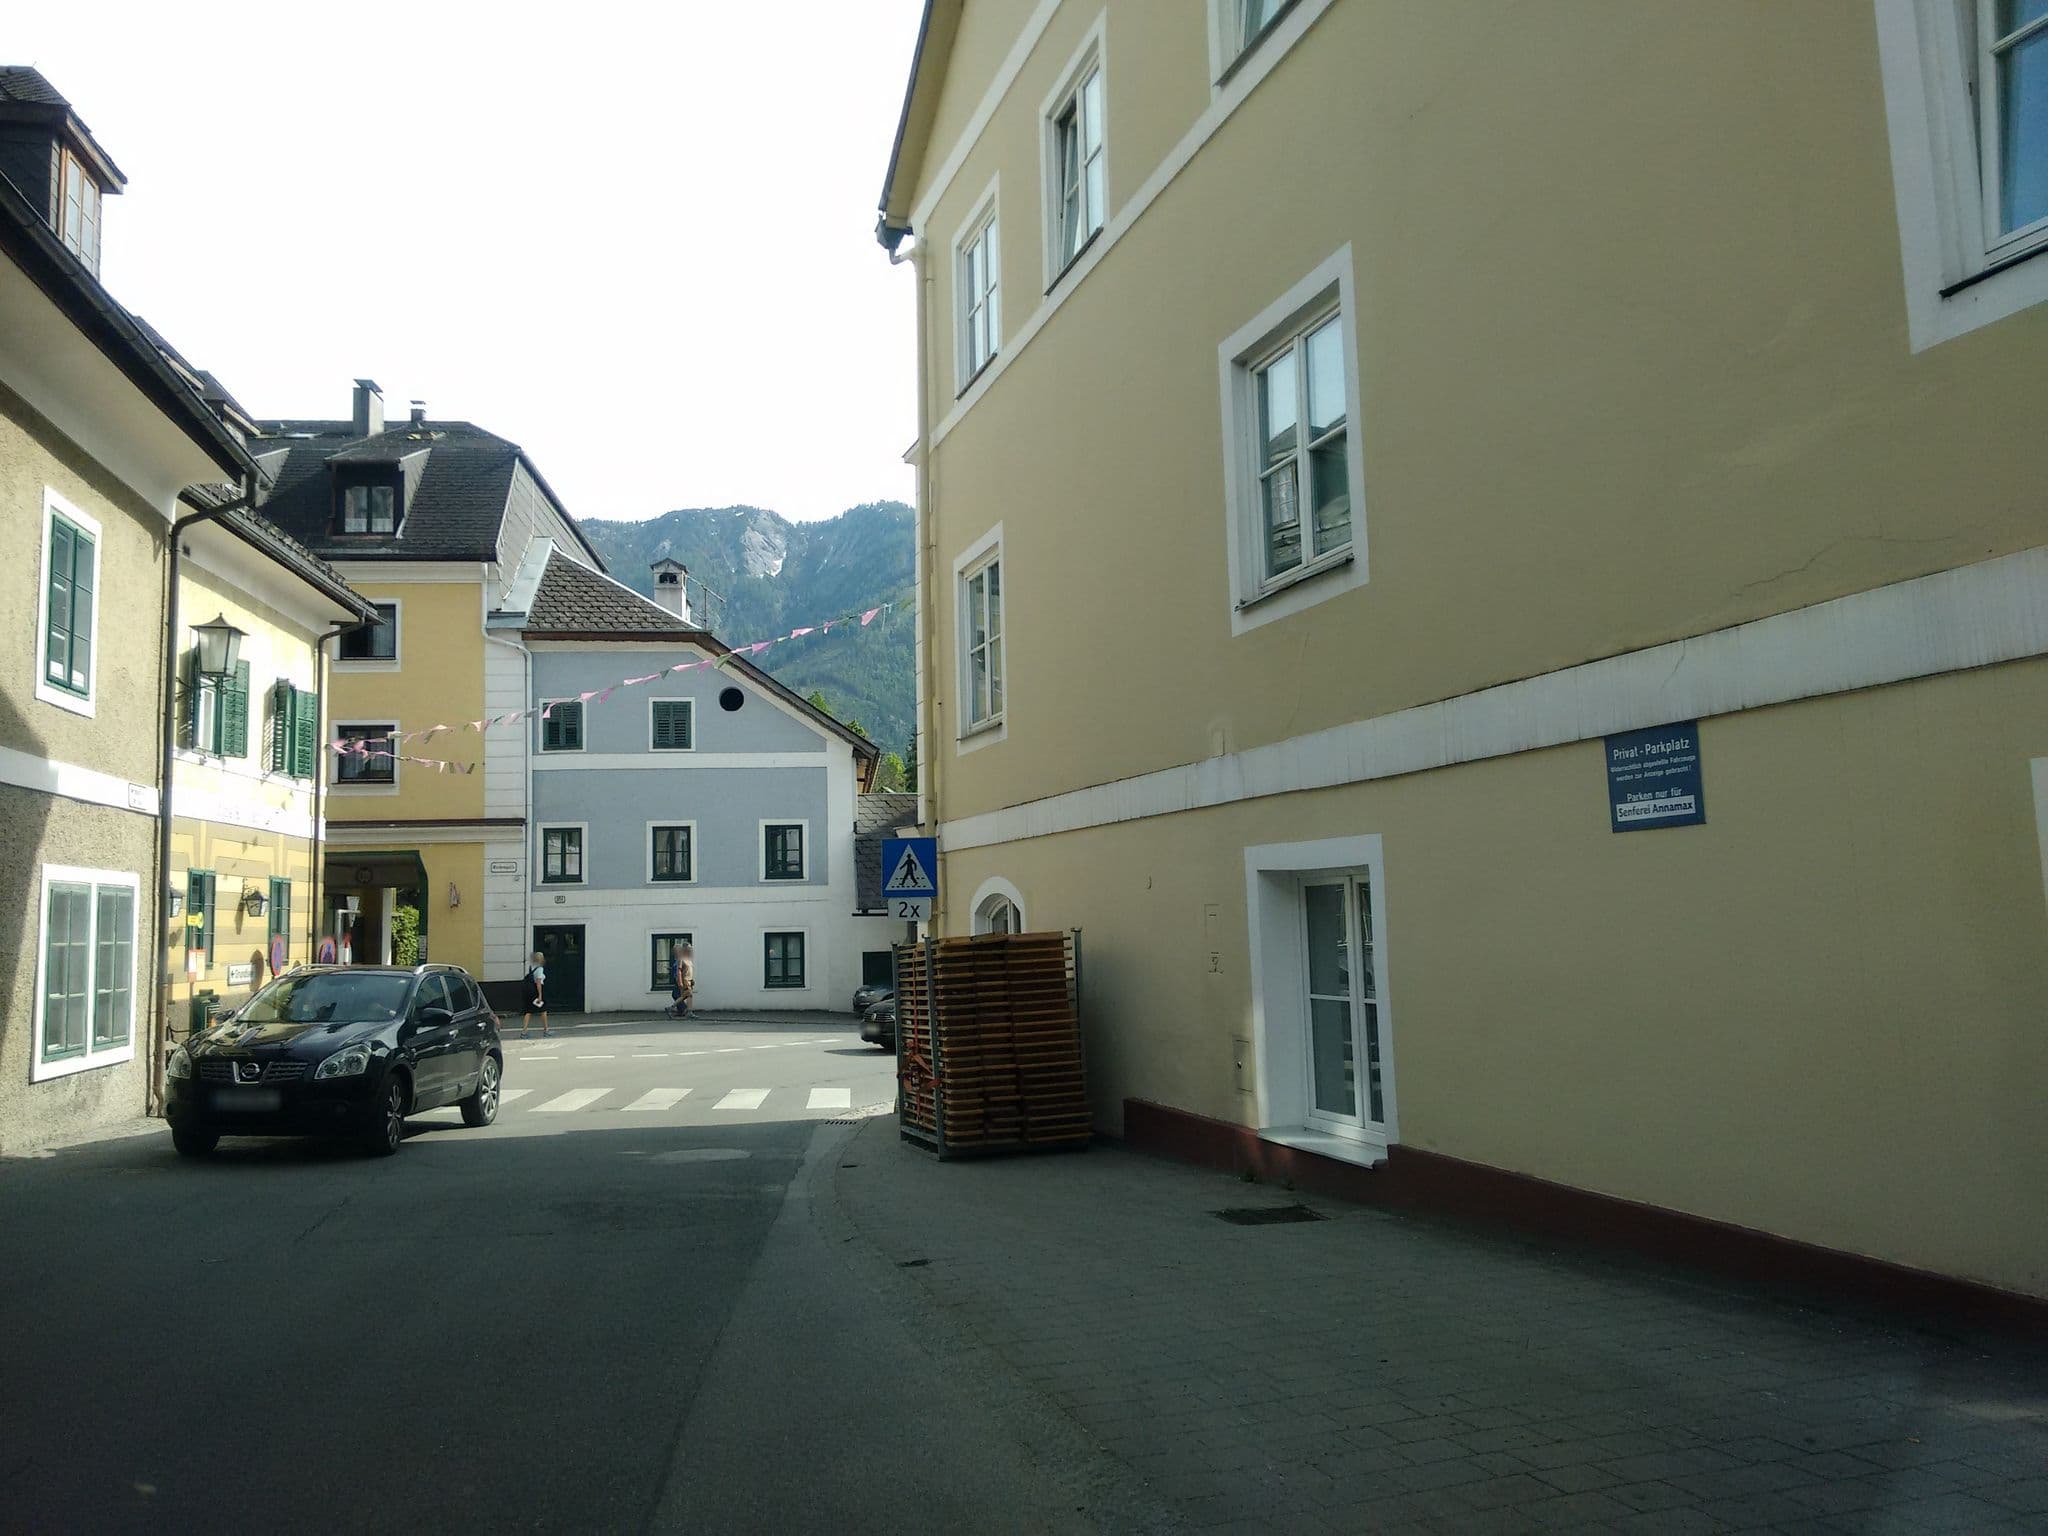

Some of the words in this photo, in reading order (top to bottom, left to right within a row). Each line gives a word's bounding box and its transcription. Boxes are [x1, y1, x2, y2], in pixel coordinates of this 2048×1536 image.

[1613, 746, 1638, 760] Privat
[1645, 738, 1690, 755] Parkplatz
[1670, 755, 1696, 764] Fahrzeuge
[1616, 774, 1633, 782] werden
[1644, 770, 1664, 779] Anzeige
[1627, 791, 1652, 802] Parken
[1655, 790, 1668, 798] nur
[1671, 787, 1682, 797] für
[1618, 804, 1651, 818] Senferei
[1652, 802, 1693, 814] Annamax
[898, 901, 920, 918] 2x
